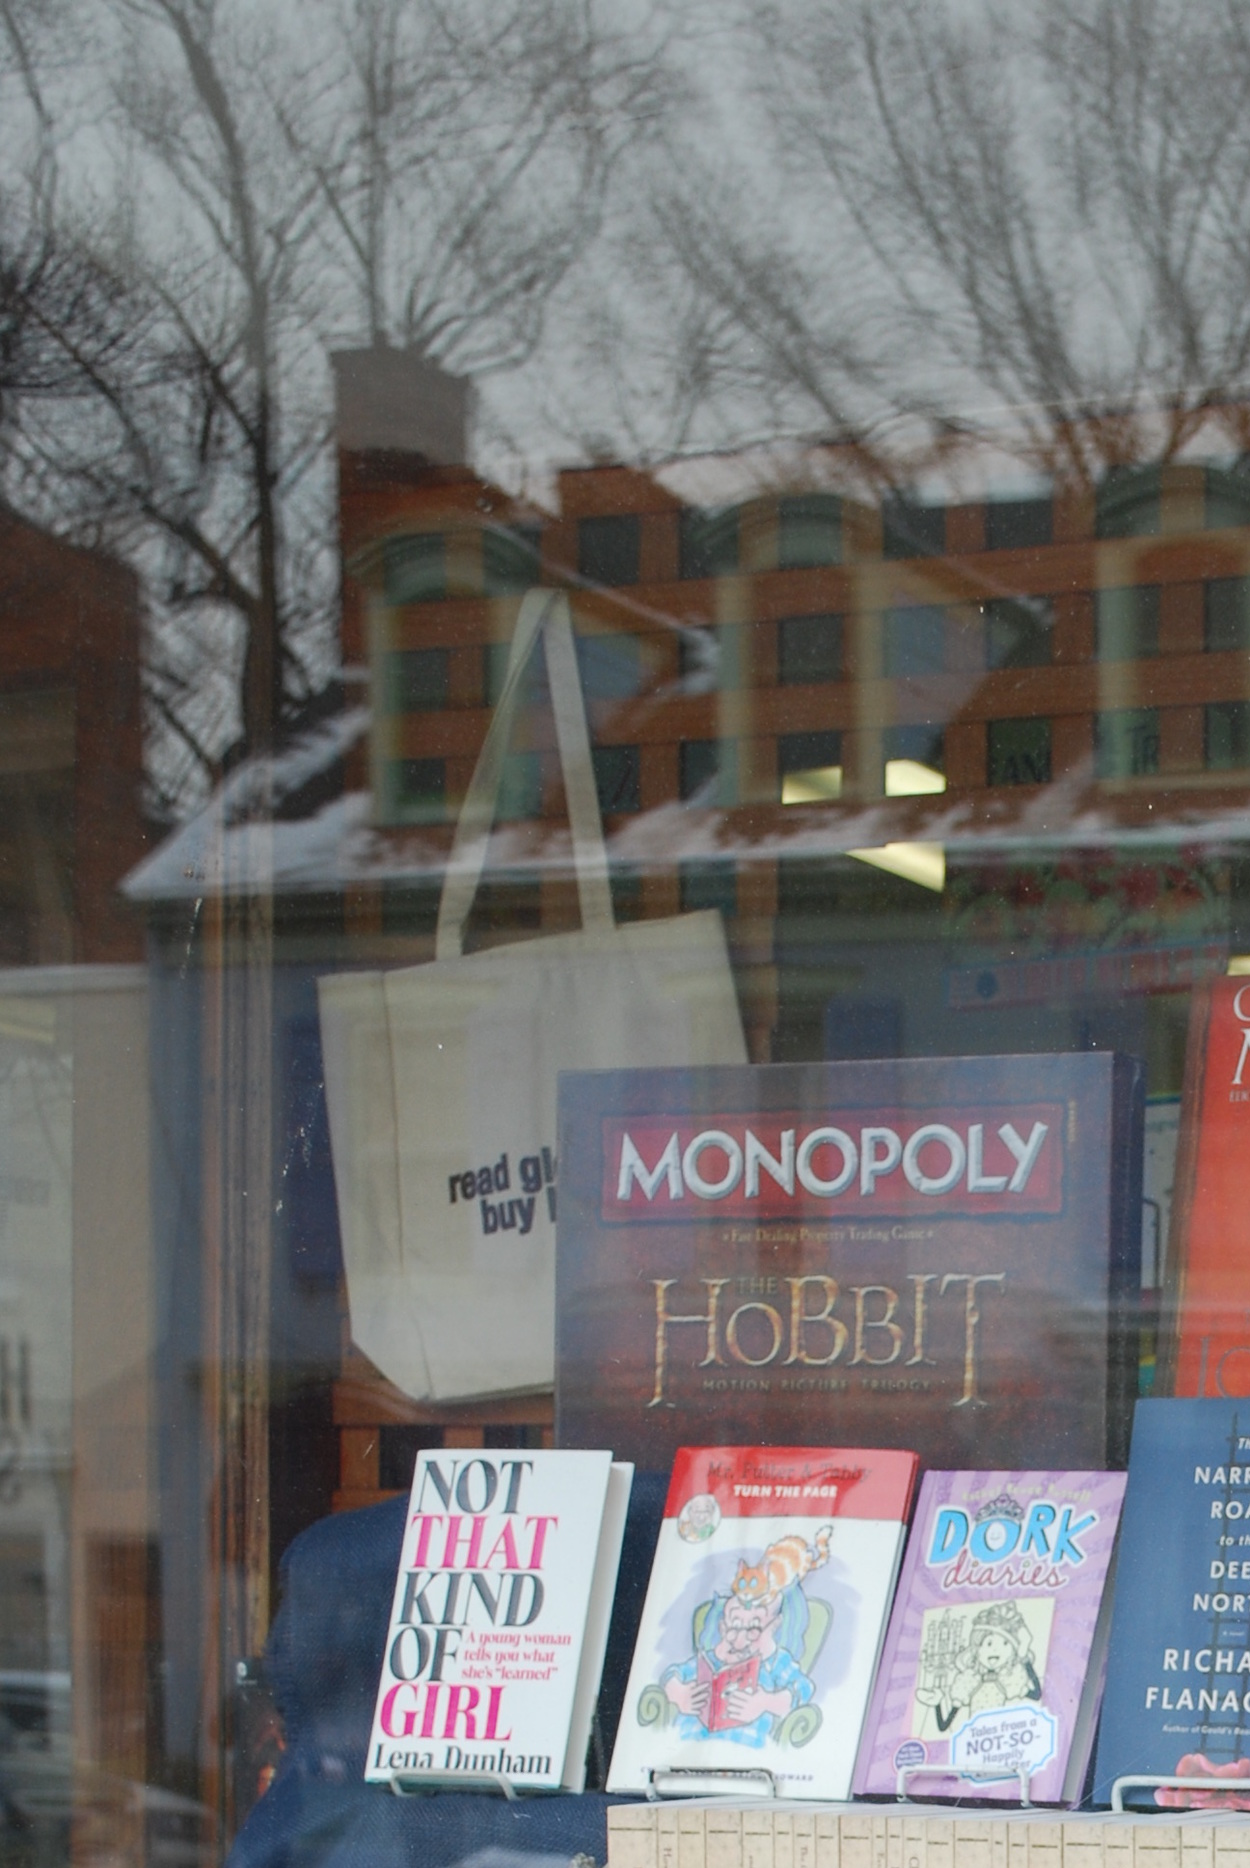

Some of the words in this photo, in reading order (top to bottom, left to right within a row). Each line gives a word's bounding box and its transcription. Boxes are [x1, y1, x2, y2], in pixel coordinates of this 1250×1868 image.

[448, 1152, 510, 1204] read
[616, 1121, 1049, 1201] MONOPOLY
[480, 1196, 536, 1235] buy
[738, 1276, 778, 1295] THE
[646, 1271, 1006, 1409] HOBBIT
[416, 1458, 535, 1515] NOT
[733, 1483, 773, 1498] TURN
[775, 1484, 801, 1498] THE
[802, 1484, 839, 1499] PAGE
[411, 1515, 559, 1570] THAT
[928, 1502, 1098, 1566] DORK
[1219, 1535, 1235, 1547] to
[942, 1549, 1068, 1588] diaries
[396, 1571, 546, 1628] KIND
[389, 1626, 463, 1682] OF
[463, 1647, 492, 1662] tells
[495, 1651, 520, 1665] you
[523, 1648, 556, 1663] what
[465, 1631, 476, 1643] A
[478, 1632, 521, 1648] young
[524, 1633, 572, 1646] woman
[461, 1664, 493, 1679] she's
[380, 1683, 514, 1742] GIRL
[373, 1743, 434, 1769] Lena
[445, 1745, 552, 1775] Dunham
[966, 1730, 1042, 1756] NOT-SO-
